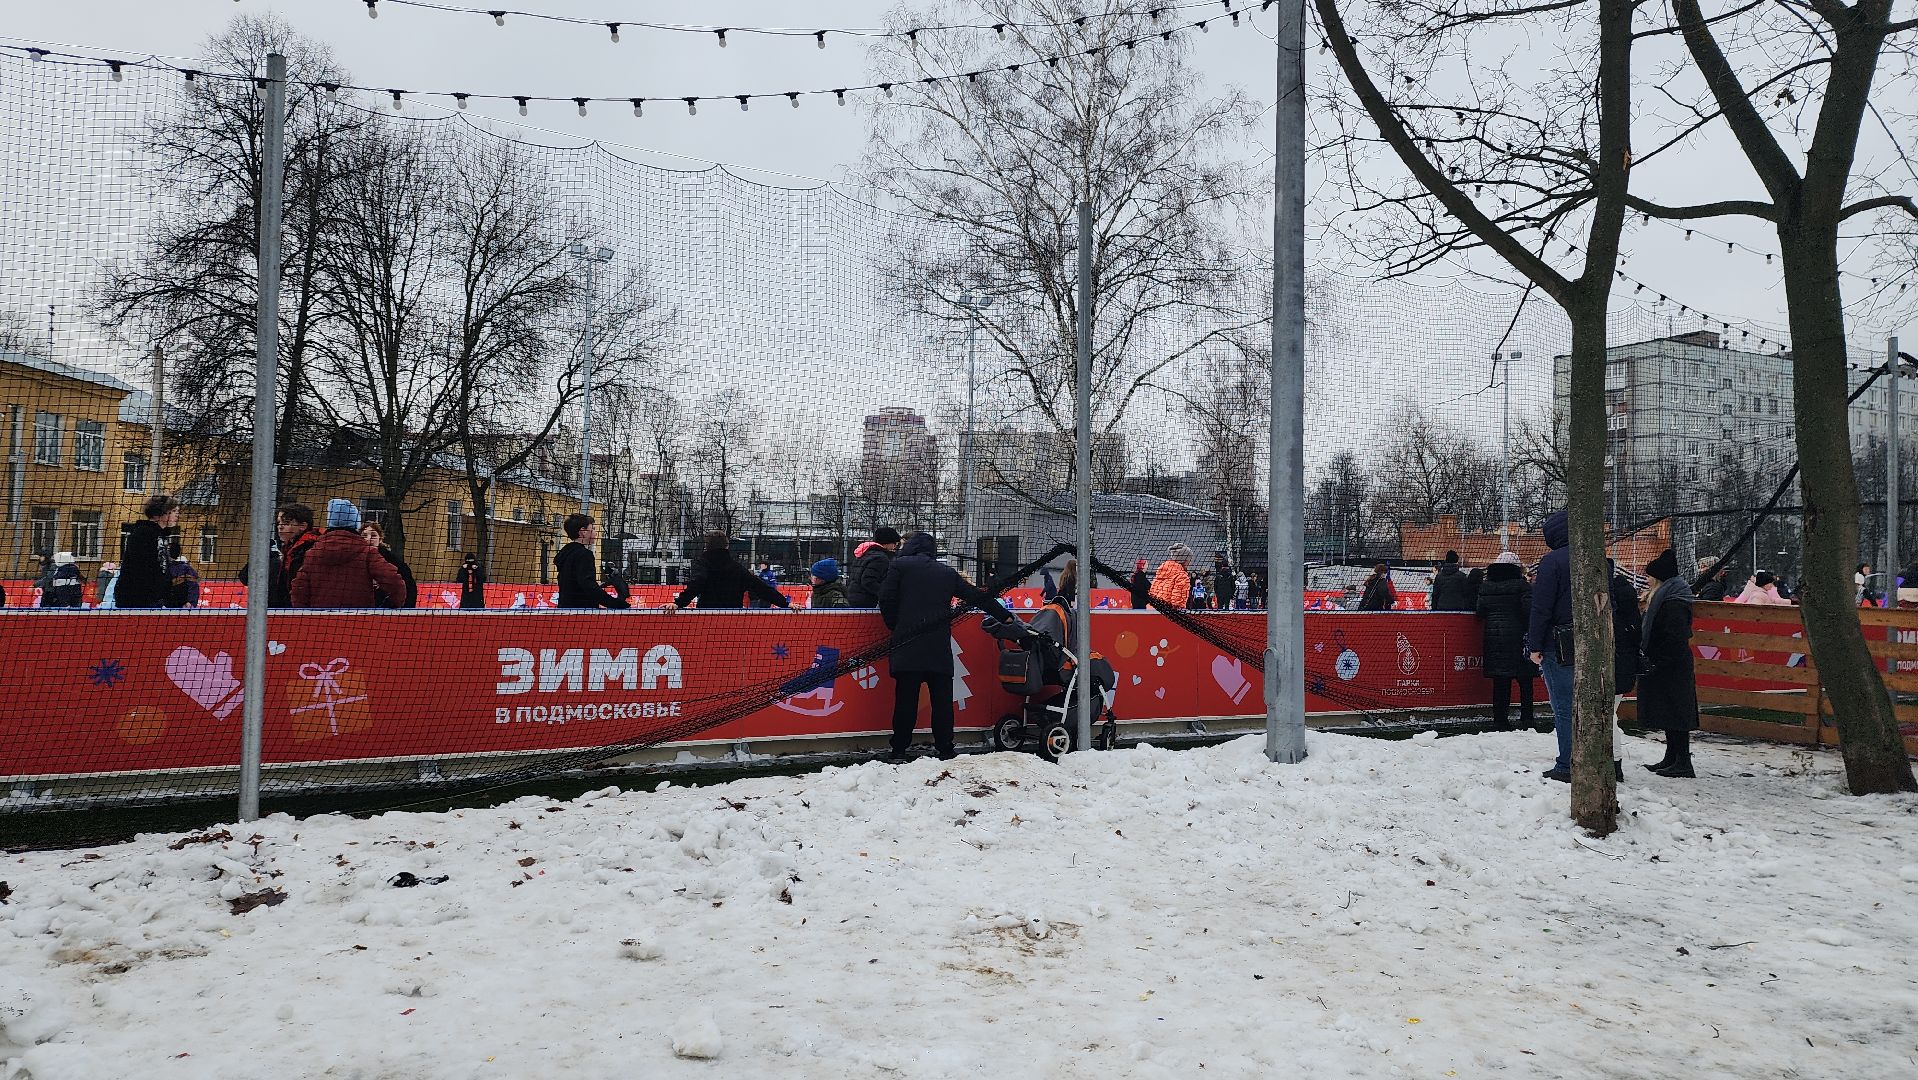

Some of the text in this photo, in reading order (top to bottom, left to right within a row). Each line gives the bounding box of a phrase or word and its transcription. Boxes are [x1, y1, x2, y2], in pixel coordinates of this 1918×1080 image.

[496, 644, 683, 695] ЗИМА
[1396, 679, 1420, 687] ПАРКИ
[495, 701, 682, 725] В ПОДМОСКОВЬЕ
